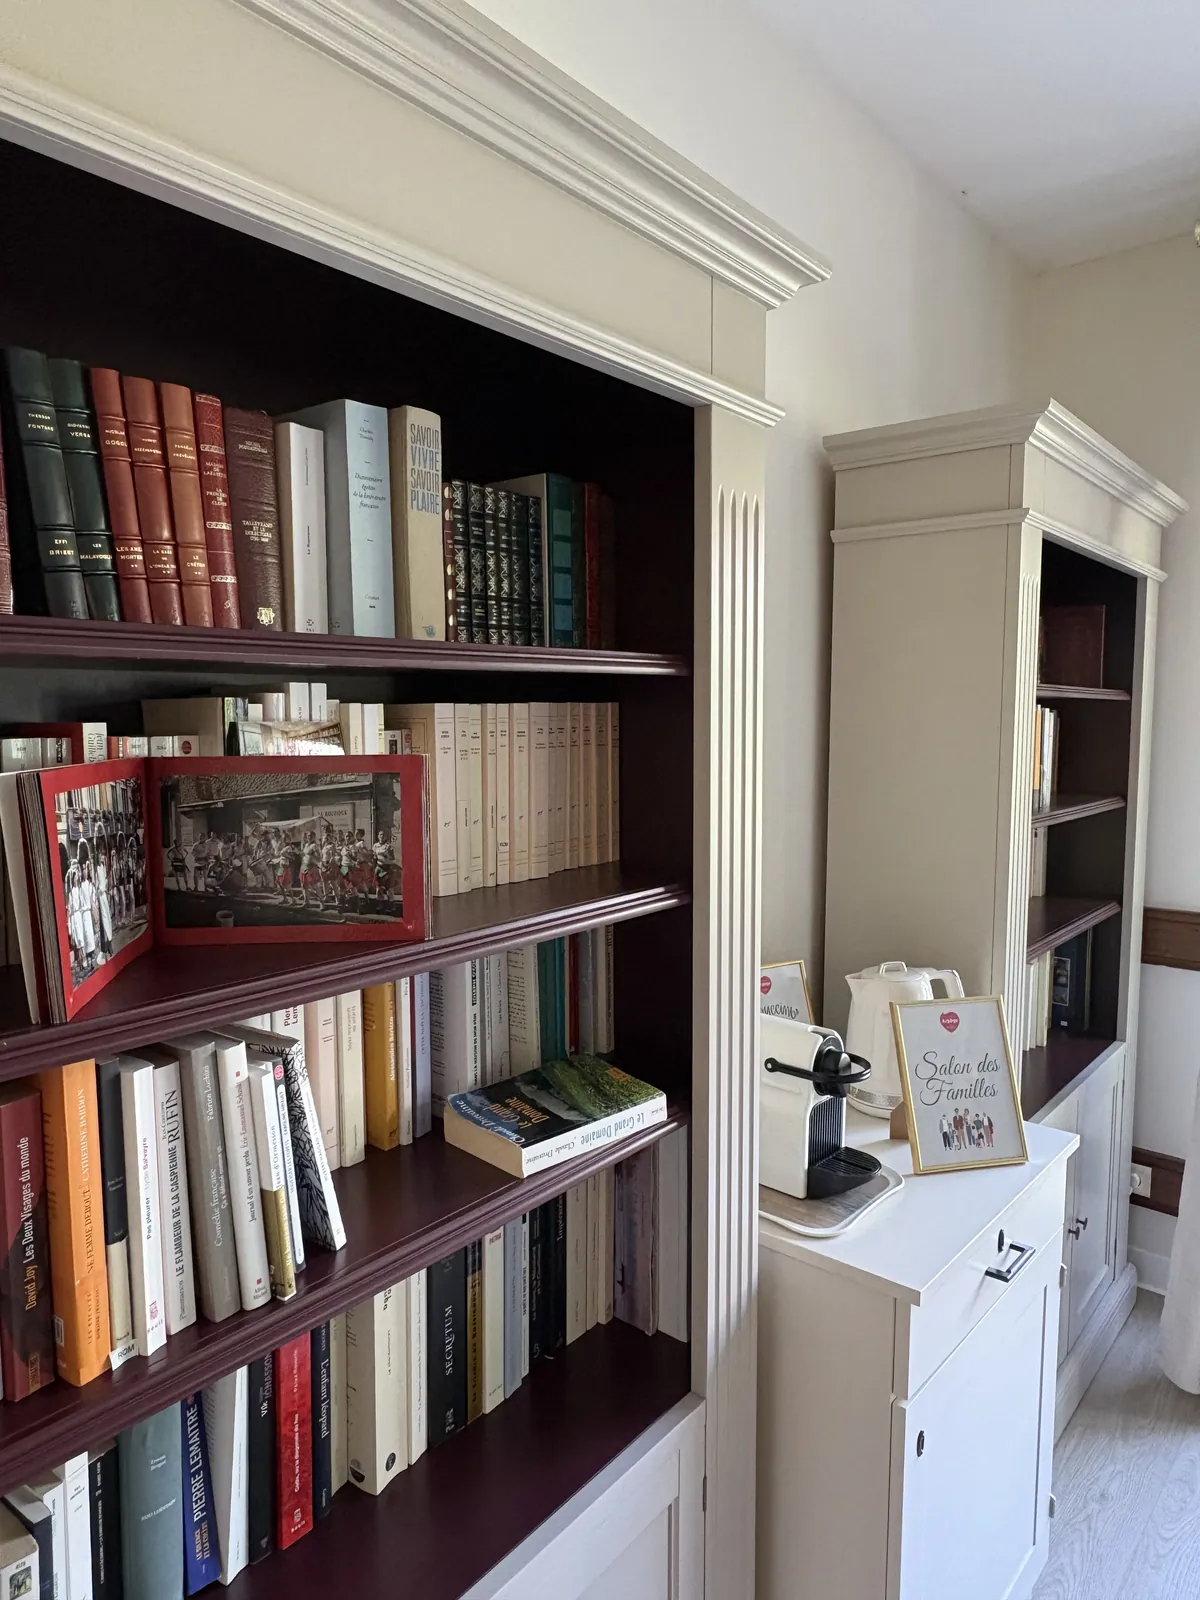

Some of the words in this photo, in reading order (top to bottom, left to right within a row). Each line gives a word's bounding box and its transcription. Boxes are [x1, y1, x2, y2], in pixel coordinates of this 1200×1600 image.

[105, 439, 128, 447] GOGOL
[410, 423, 440, 450] SAVOIR
[410, 444, 440, 472] VIVRE
[410, 467, 440, 494] SAVOIR
[410, 489, 440, 515] PLAIRE
[388, 1042, 396, 1081] Alessandro
[914, 1051, 973, 1080] Salon
[976, 1052, 1001, 1073] des
[203, 1065, 213, 1093] Luchini
[919, 1078, 999, 1107] Familles
[77, 1088, 87, 1129] BARDON
[164, 1088, 181, 1145] RUFIN
[206, 1093, 215, 1122] Fabrice
[487, 1102, 521, 1126] Grand
[504, 1096, 550, 1125] Domaine
[636, 1112, 645, 1125] Le
[518, 1120, 533, 1130] Le
[580, 1124, 612, 1147] Domaine
[613, 1115, 636, 1136] Grand
[16, 1136, 30, 1169] monde
[79, 1129, 90, 1183] CATHERINE
[242, 1150, 253, 1168] perdu
[18, 1169, 31, 1183] du
[167, 1145, 180, 1192] CASPIENNE
[20, 1182, 35, 1220] Visages
[170, 1193, 180, 1206] LA
[210, 1168, 219, 1208] française
[81, 1187, 92, 1226] DEBOUT
[171, 1206, 181, 1219] DE
[247, 1201, 257, 1223] Journal
[21, 1219, 34, 1245] Deux
[211, 1208, 223, 1247] Comédie
[22, 1244, 35, 1264] Les
[83, 1226, 94, 1260] FEMME
[172, 1222, 184, 1263] FLAMBEUR
[28, 1265, 39, 1284] Joy
[175, 1265, 185, 1278] LE
[25, 1283, 37, 1311] David
[444, 1304, 456, 1377] SECRETUM
[320, 1358, 330, 1402] L'enfant
[318, 1401, 330, 1440] léopard
[186, 1403, 204, 1469] LEMAITRE
[191, 1469, 207, 1523] PIERRE
